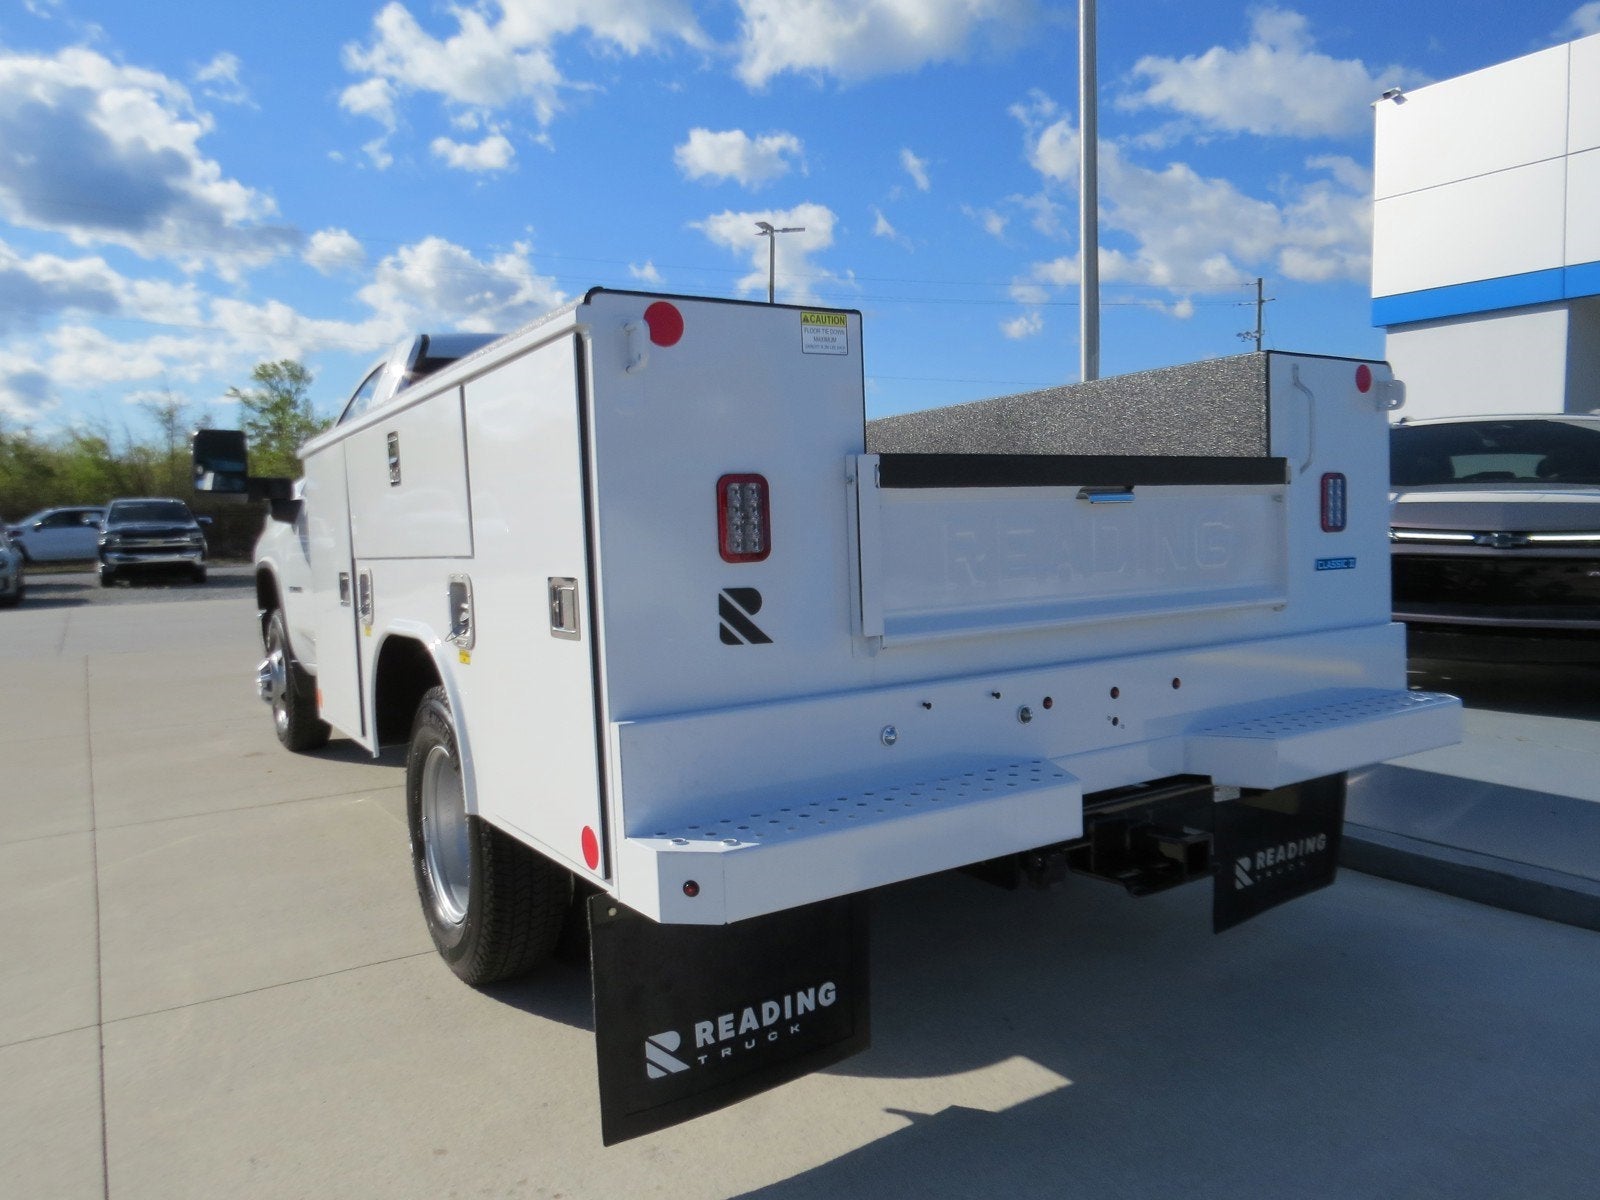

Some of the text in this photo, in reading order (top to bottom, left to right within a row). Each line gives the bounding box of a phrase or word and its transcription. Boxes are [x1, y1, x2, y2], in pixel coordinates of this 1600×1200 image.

[810, 314, 846, 325] CAUTION
[1317, 559, 1348, 569] CLASSIC
[1256, 833, 1327, 870] READING
[695, 981, 836, 1048] READING
[698, 1023, 800, 1065] TRUCK
